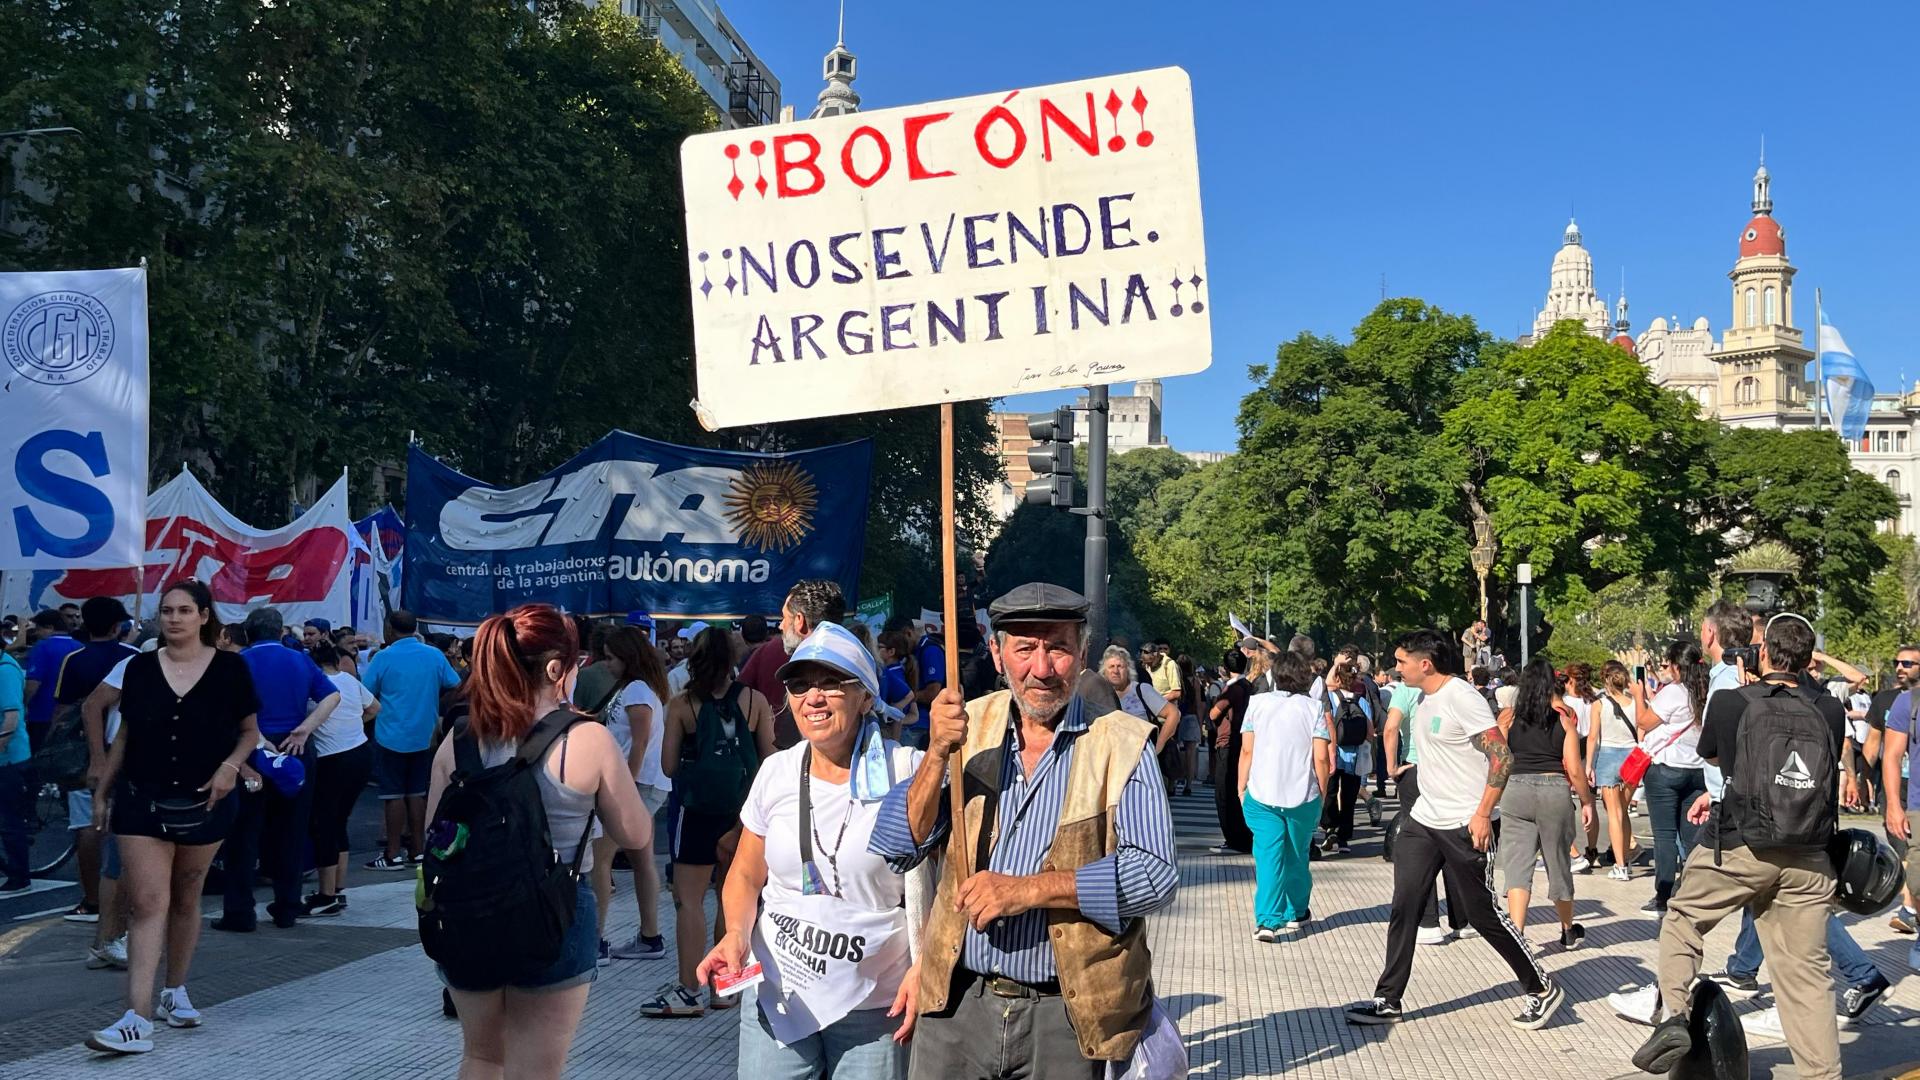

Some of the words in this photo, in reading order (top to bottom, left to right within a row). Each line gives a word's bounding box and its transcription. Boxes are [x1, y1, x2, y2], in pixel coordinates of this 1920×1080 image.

[86, 330, 110, 371] TRABAJO
[12, 429, 115, 558] S
[446, 562, 489, 576] central
[493, 564, 511, 577] de
[515, 556, 606, 574] trabajadorxs
[497, 577, 515, 590] de
[519, 576, 532, 588] la
[535, 569, 605, 588] argentina
[608, 551, 770, 583] autónoma
[1774, 774, 1816, 789] Reebok
